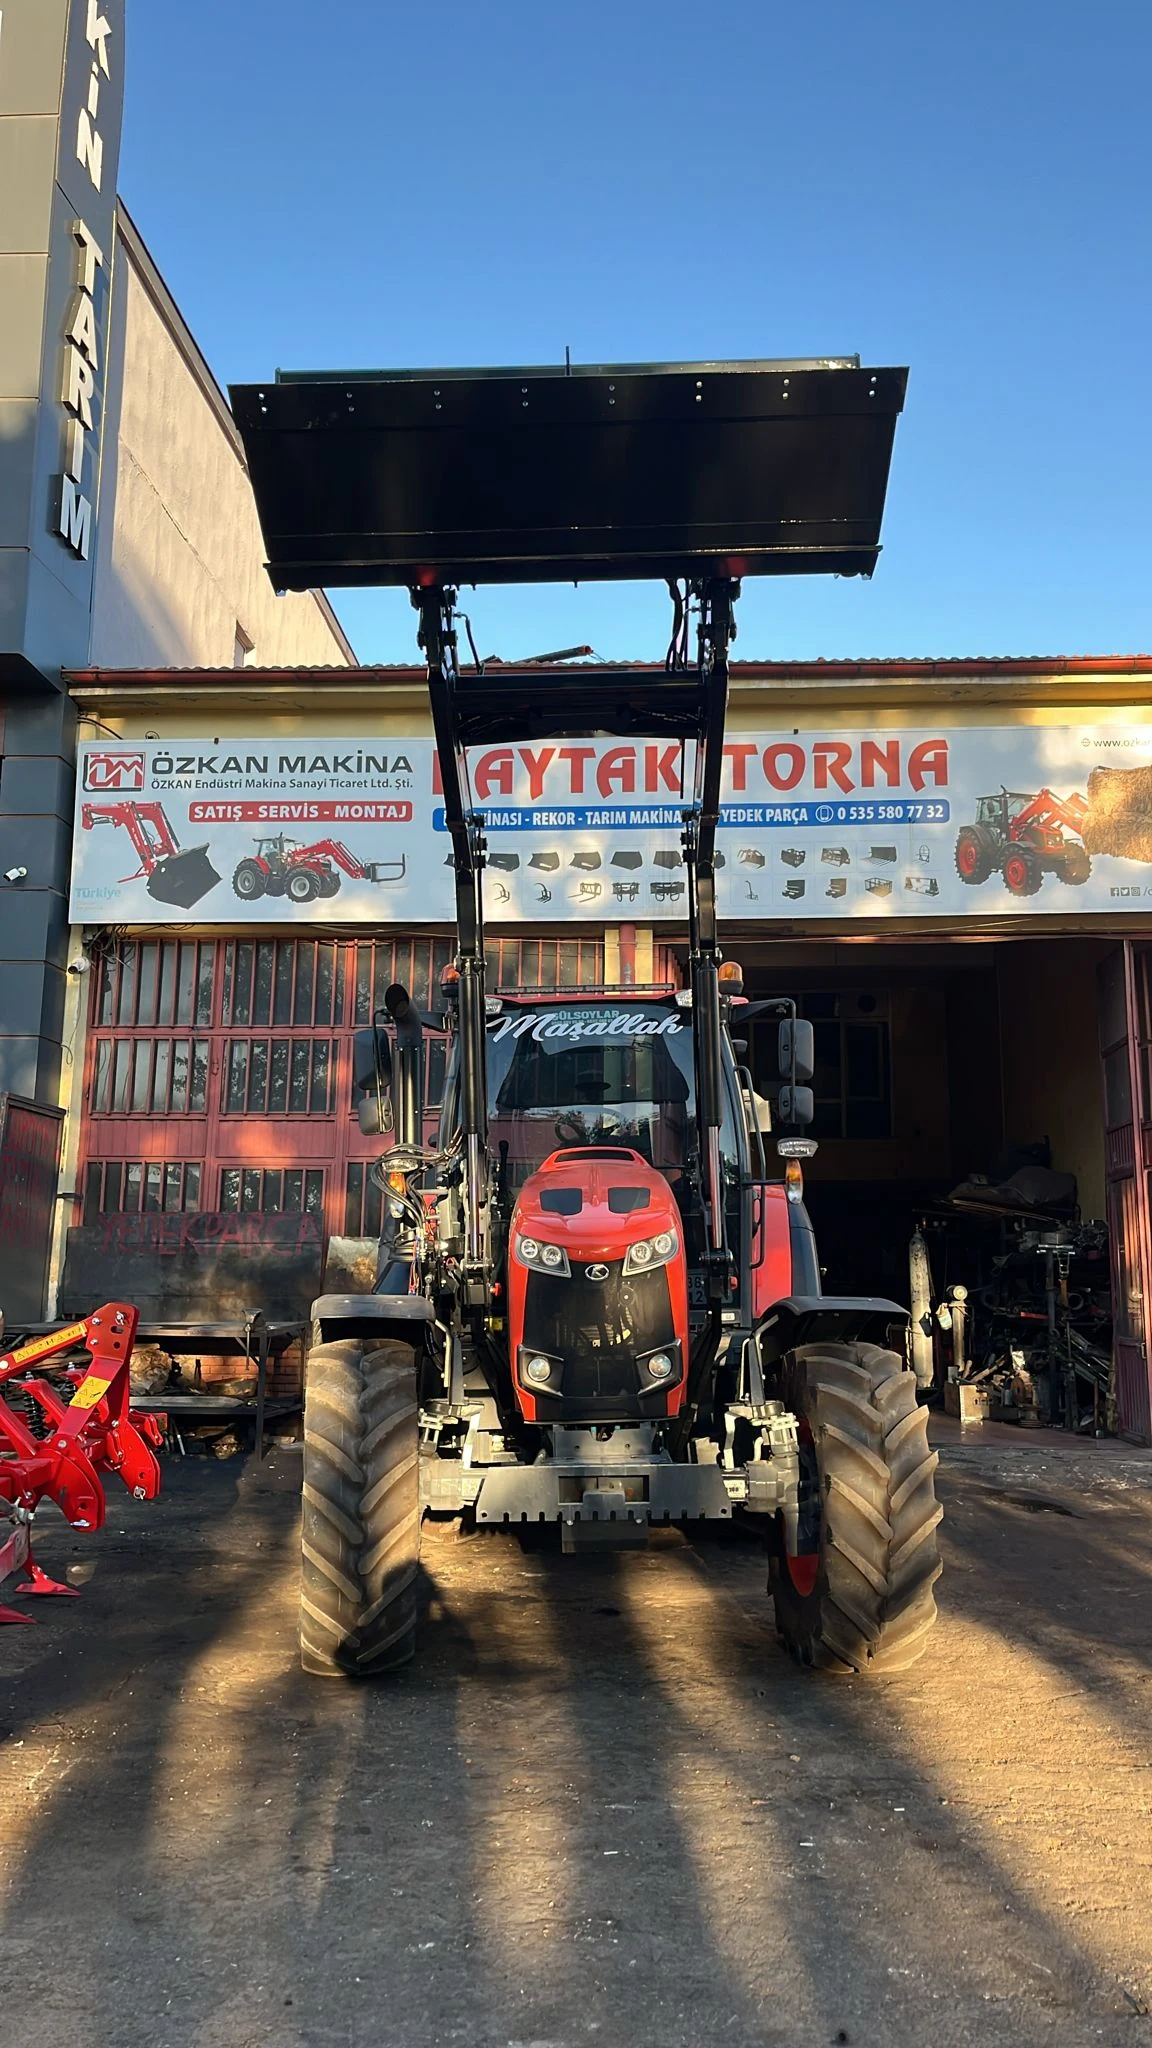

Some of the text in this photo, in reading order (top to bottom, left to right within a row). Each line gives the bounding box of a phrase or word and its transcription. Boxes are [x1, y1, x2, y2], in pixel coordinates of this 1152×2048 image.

[52, 218, 102, 561] TARIM
[151, 749, 413, 775] ÖZKAN MAKİNA
[722, 740, 948, 794] TORNA
[151, 778, 413, 791] ÖZKAN Endüstri Makina Sanayi Ticaret Ltd. Şti.
[194, 804, 243, 821] SATIŞ
[258, 802, 319, 819] SERVİS
[334, 804, 407, 819] MONTAJ
[532, 811, 575, 826] REKOR
[585, 810, 627, 825] TARIM
[722, 808, 762, 823] YEDEK
[765, 807, 808, 825] PARÇA
[837, 808, 844, 821] 0
[850, 807, 874, 820] 535
[878, 806, 902, 820] 580
[906, 805, 923, 818] 77
[926, 804, 943, 817] 32
[75, 887, 121, 900] Türkiye
[486, 1013, 684, 1043] Maşallah
